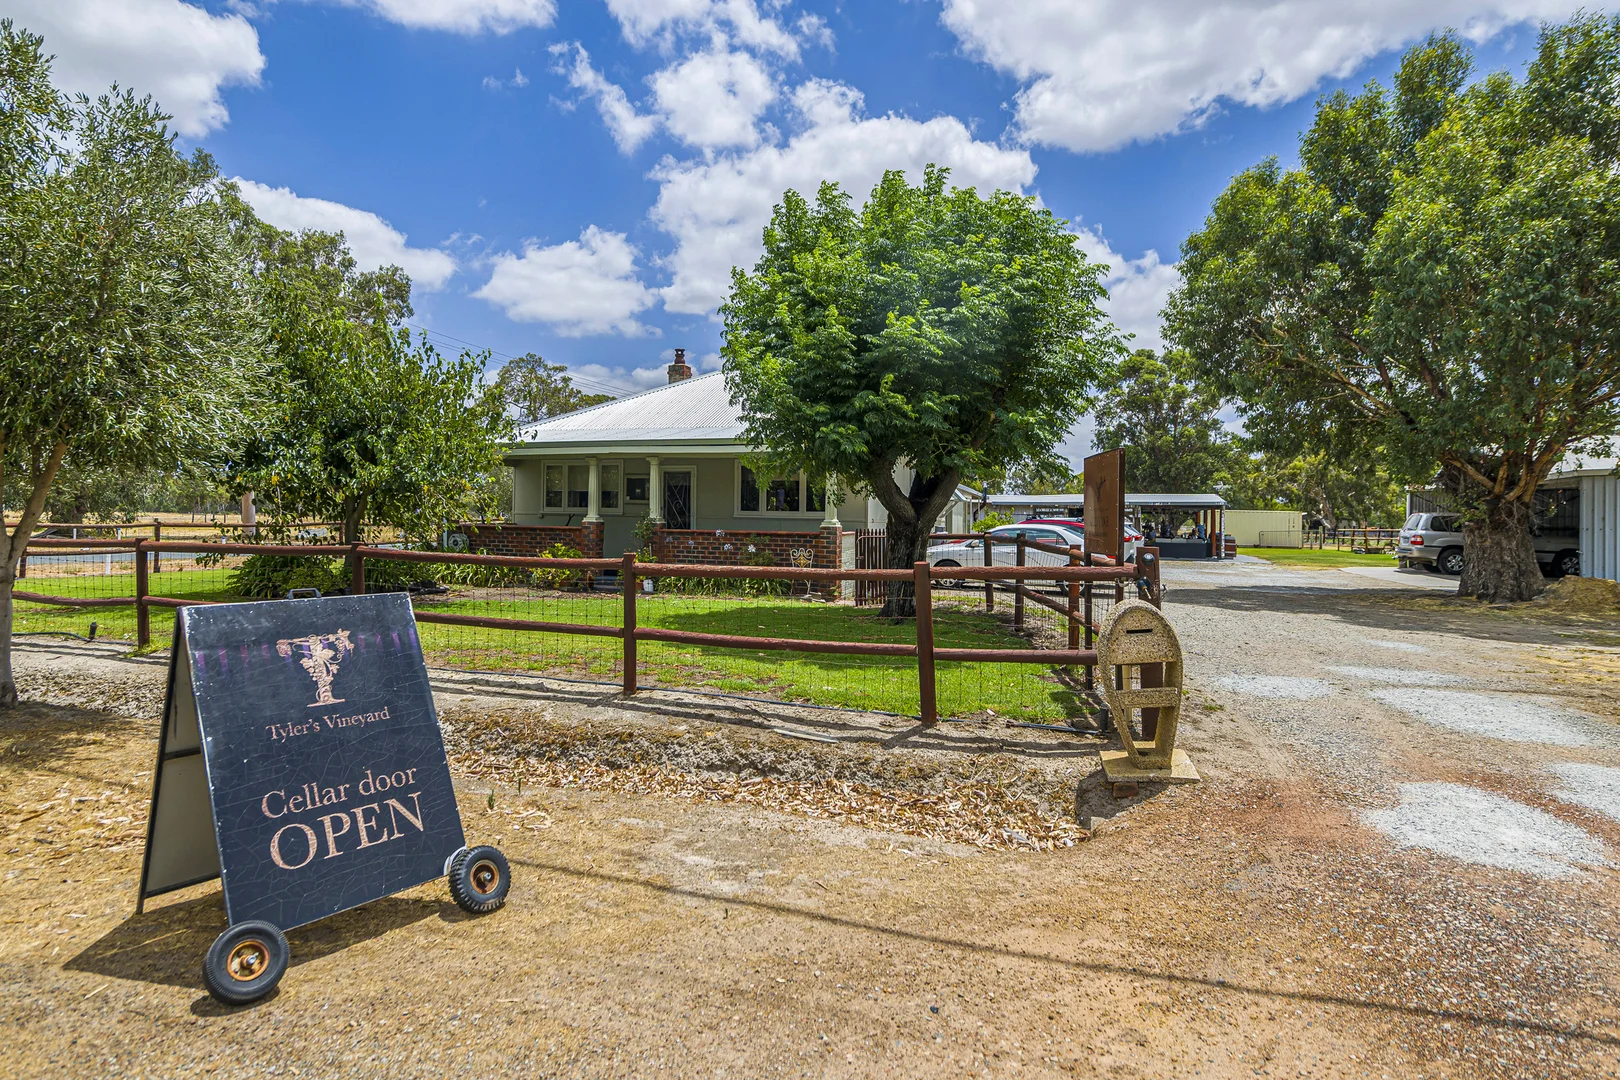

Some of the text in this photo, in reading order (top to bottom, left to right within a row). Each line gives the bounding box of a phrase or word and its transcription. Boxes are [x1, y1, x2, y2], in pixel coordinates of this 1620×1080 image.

[265, 706, 391, 743] Tyler's Vineyard
[261, 767, 417, 818] Cellar door
[269, 791, 424, 870] OPEN
